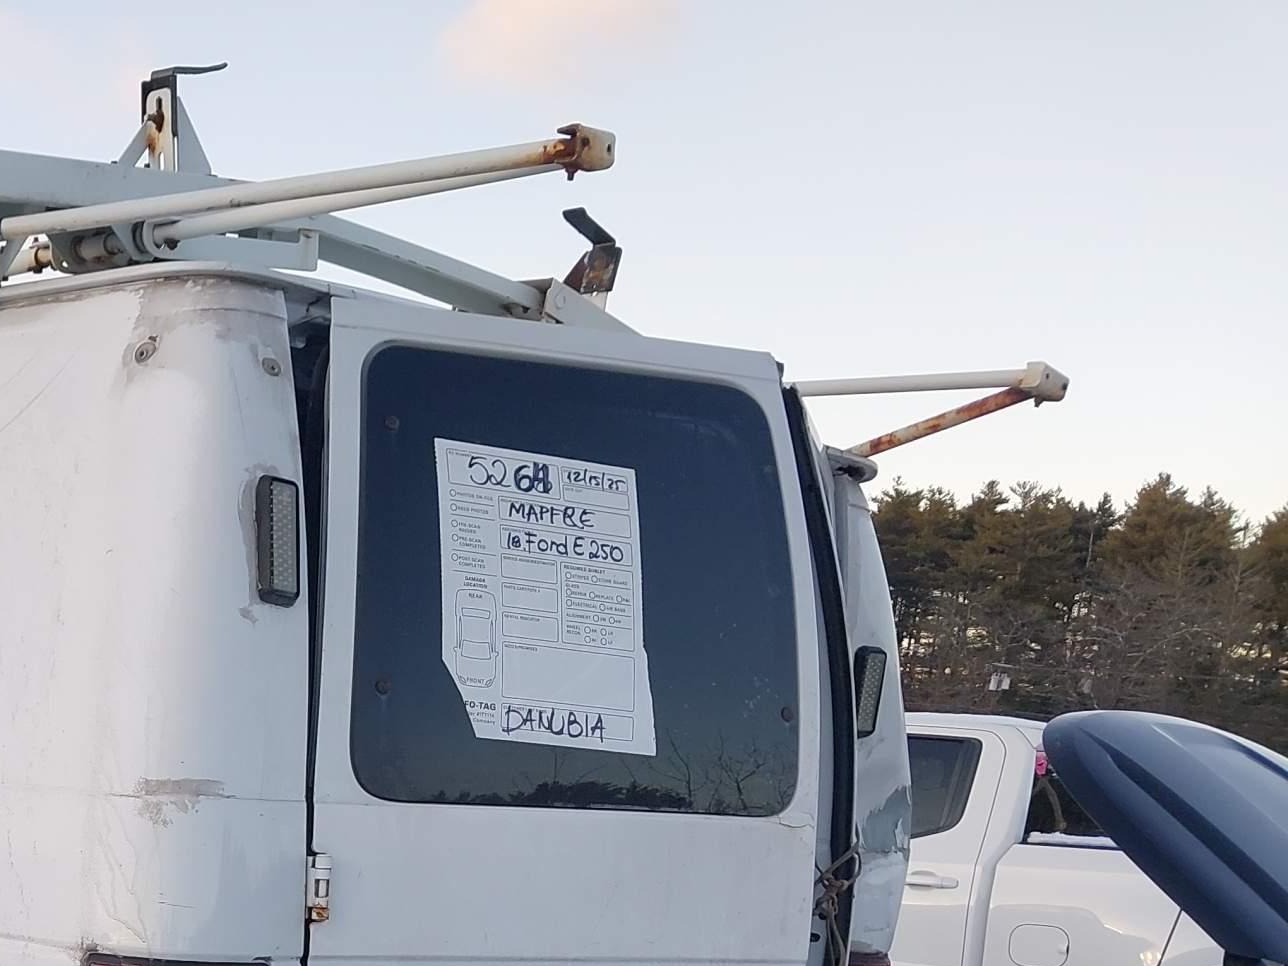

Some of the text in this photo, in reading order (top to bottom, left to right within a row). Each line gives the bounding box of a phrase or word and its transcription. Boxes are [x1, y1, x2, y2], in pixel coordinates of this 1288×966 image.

[508, 502, 596, 529] MAPFRE
[524, 531, 569, 556] Ford
[466, 676, 485, 685] FRONT
[502, 705, 606, 743] DANUBIA
